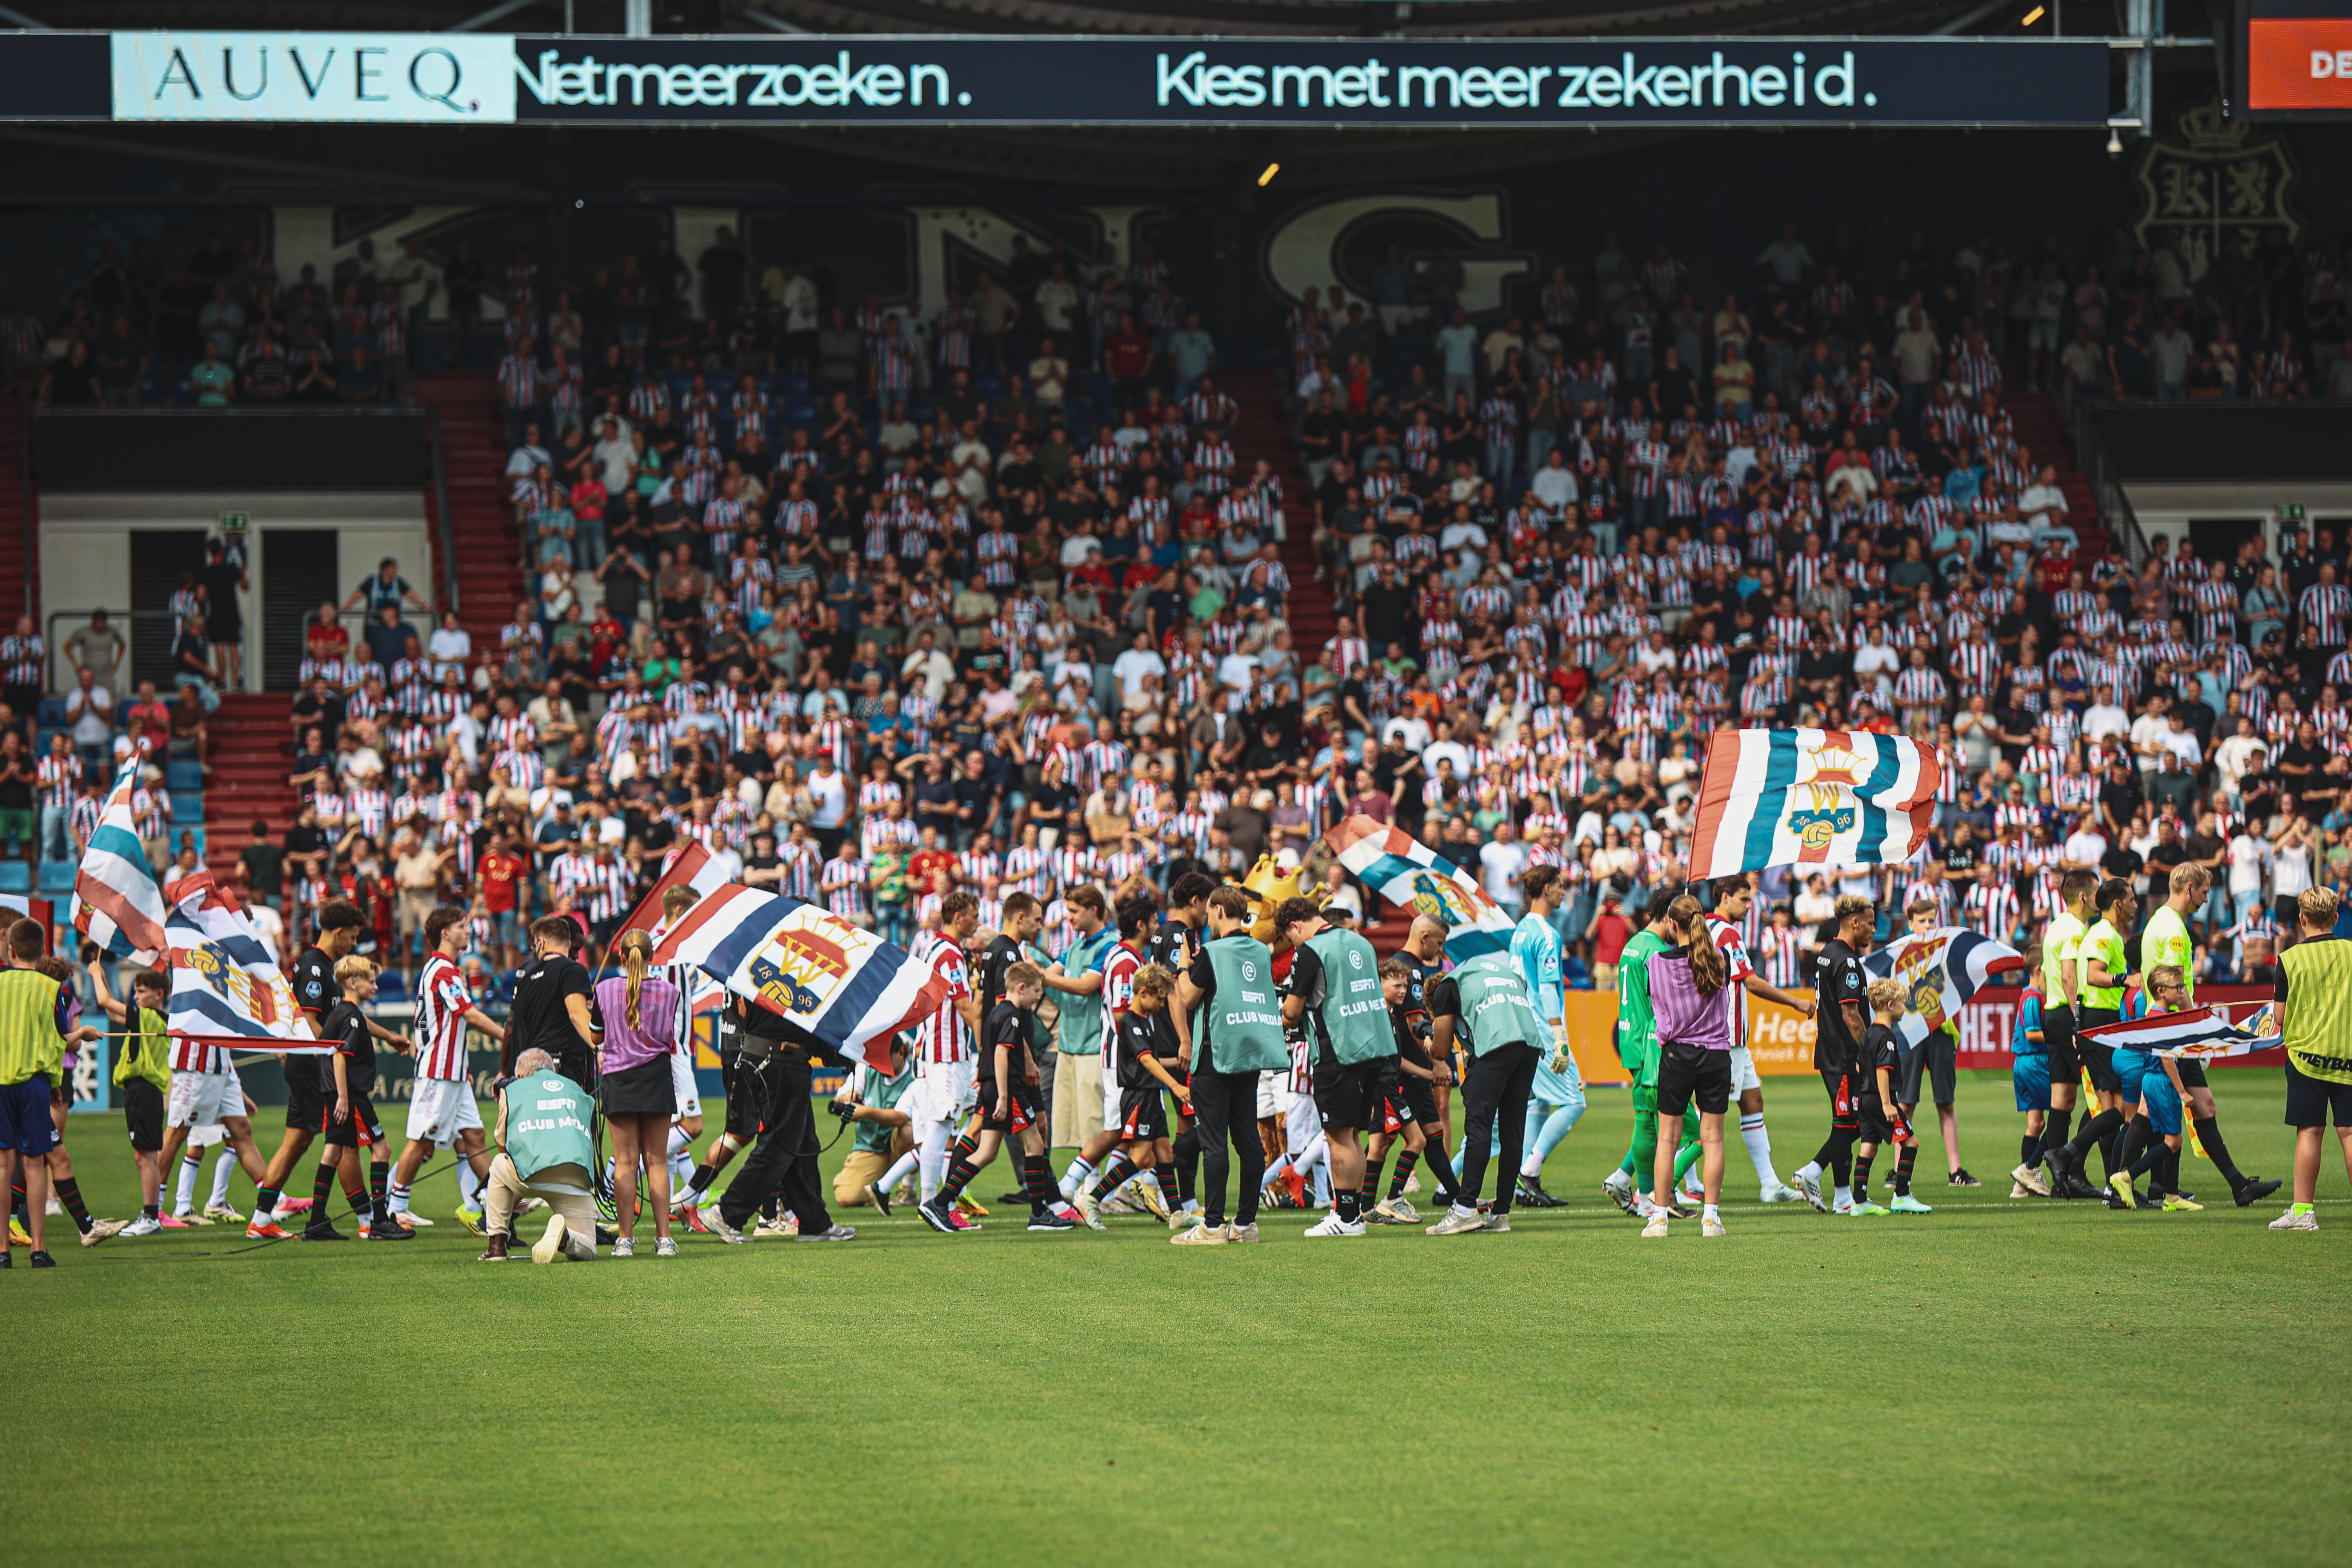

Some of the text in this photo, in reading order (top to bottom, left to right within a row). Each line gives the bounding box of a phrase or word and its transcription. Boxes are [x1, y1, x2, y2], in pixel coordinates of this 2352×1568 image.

[1272, 59, 1391, 107] met
[1398, 66, 1552, 107] meer
[1558, 51, 1877, 107] zekerheid.
[1837, 813, 1850, 829] 96
[758, 964, 773, 979] 18
[1350, 978, 1375, 993] ESPN
[1483, 977, 1518, 989] ESPN
[798, 994, 812, 1007] 96
[1241, 990, 1266, 1004] ESPN
[1340, 1000, 1368, 1017] CLUB
[1226, 1011, 1283, 1027] CLUB MEDIA
[1754, 1012, 1818, 1044] Hee
[1959, 1003, 2015, 1052] HET
[537, 1098, 576, 1111] ESPN
[518, 1119, 555, 1133] CLUB
